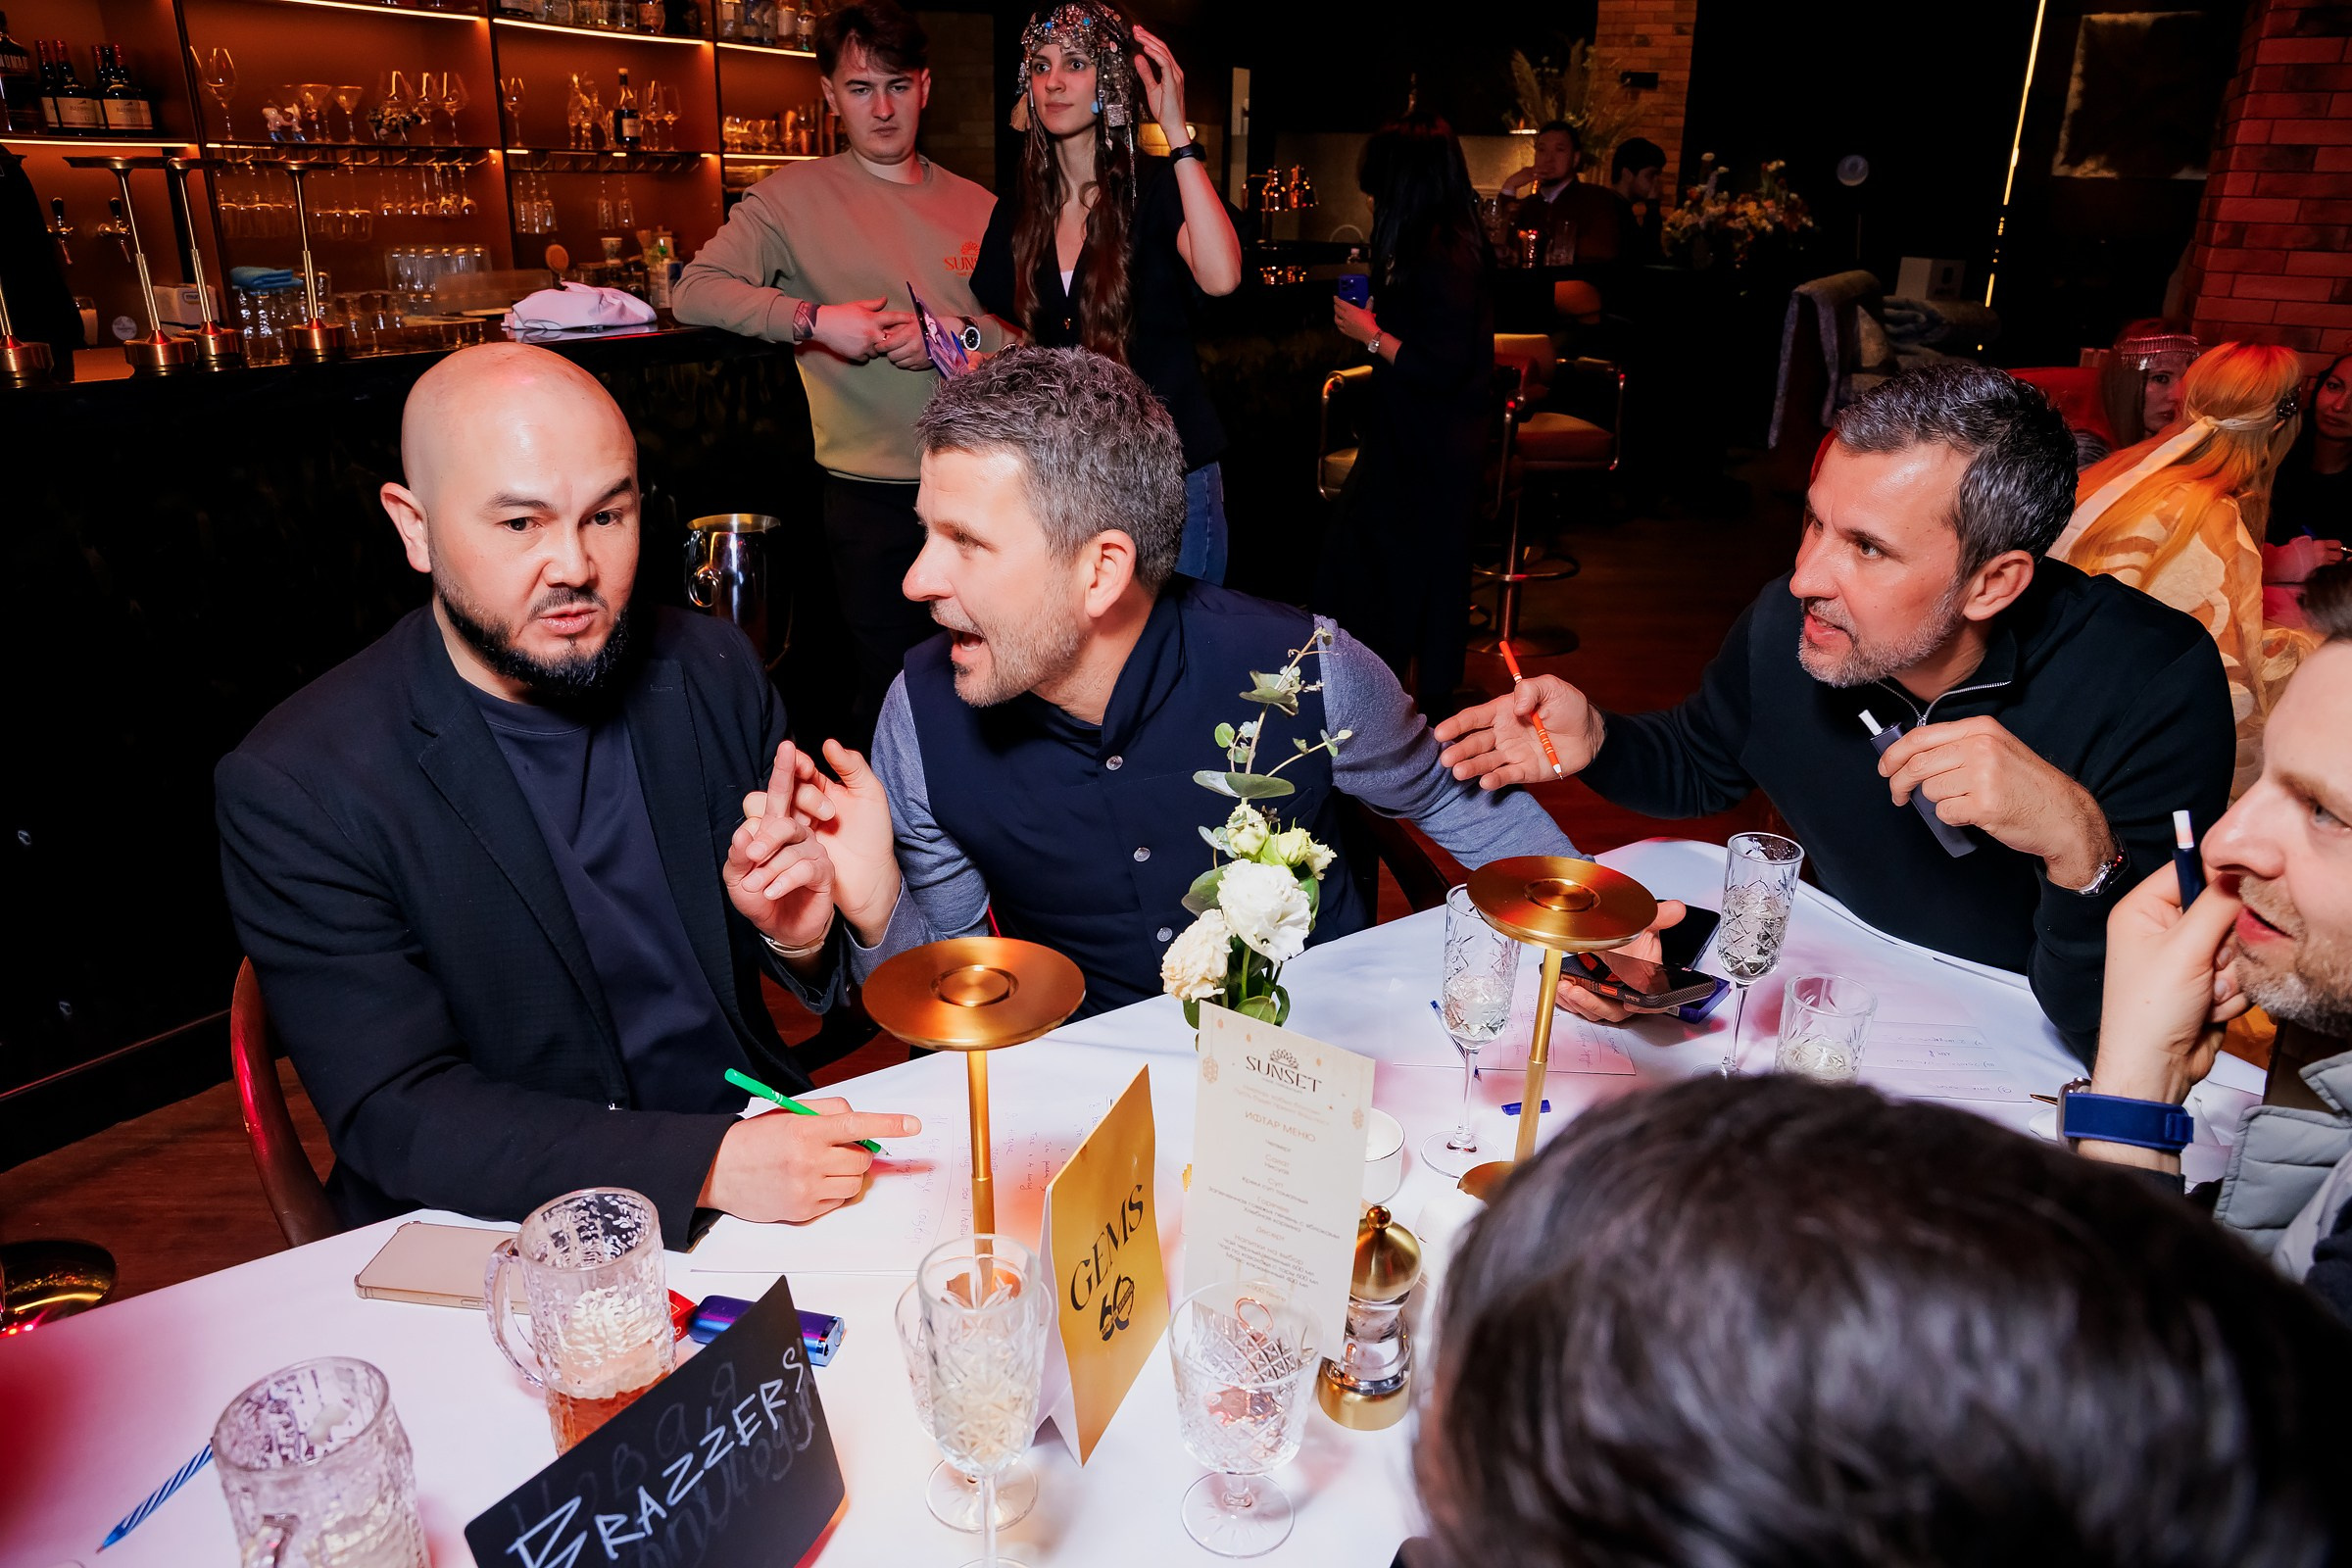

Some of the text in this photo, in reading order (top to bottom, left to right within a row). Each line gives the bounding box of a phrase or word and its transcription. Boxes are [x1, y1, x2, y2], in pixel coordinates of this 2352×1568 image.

[1246, 1055, 1322, 1093] SUNSET
[1245, 1110, 1315, 1143] ИФТАР МЕНЮ
[1262, 1184, 1274, 1193] суп
[1267, 1178, 1284, 1189] Суп
[1256, 1226, 1285, 1241] Десерт
[1070, 1184, 1144, 1311] GEMS
[1226, 1251, 1243, 1263] Морс
[1235, 1234, 1303, 1266] Напитки на выбор
[1309, 1277, 1319, 1286] мл
[506, 1346, 803, 1568] BRAZZERS
